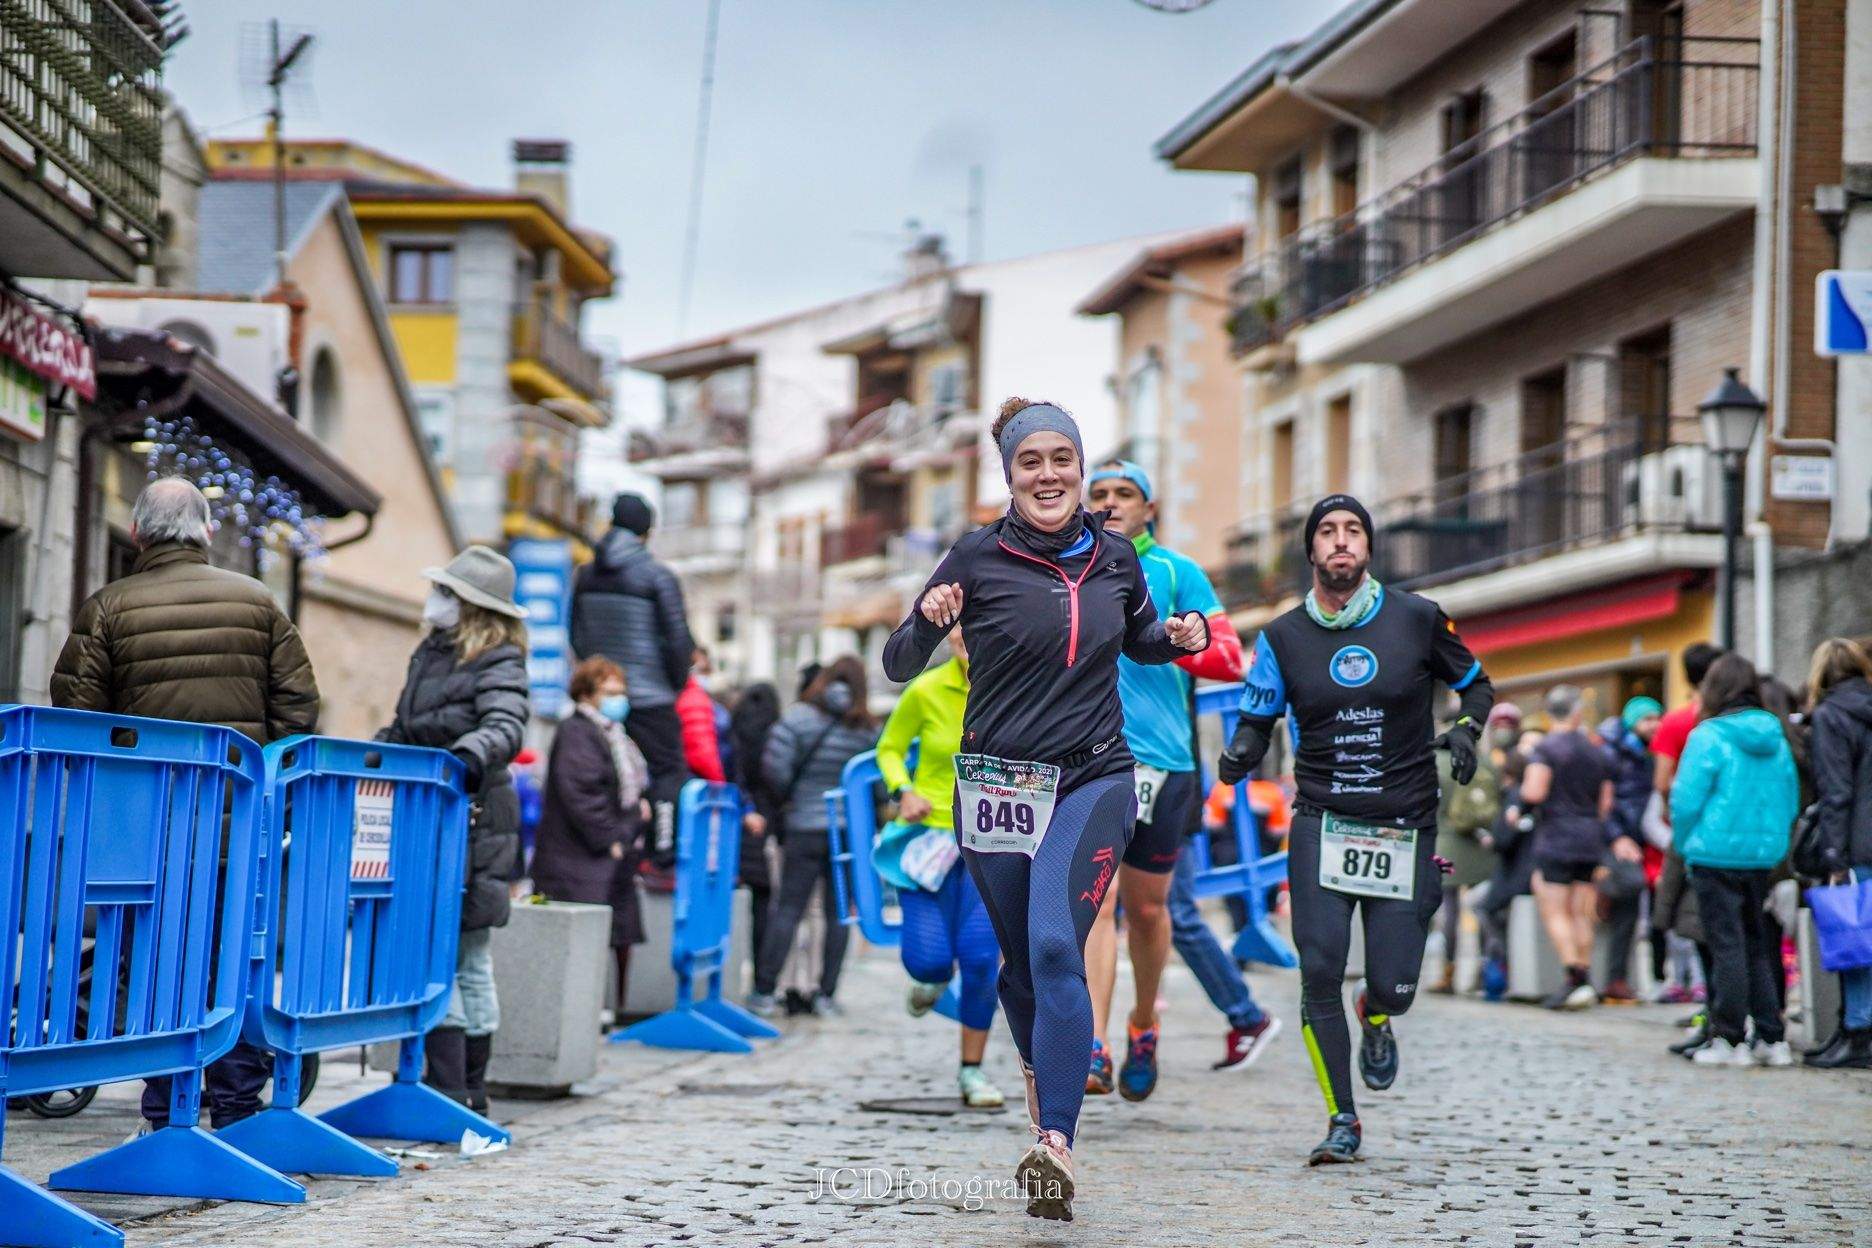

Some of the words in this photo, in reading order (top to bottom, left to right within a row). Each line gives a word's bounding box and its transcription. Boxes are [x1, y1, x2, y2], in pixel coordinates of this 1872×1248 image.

[1336, 707, 1384, 721] Adeslas
[977, 799, 1035, 835] 849
[1343, 848, 1391, 879] 879
